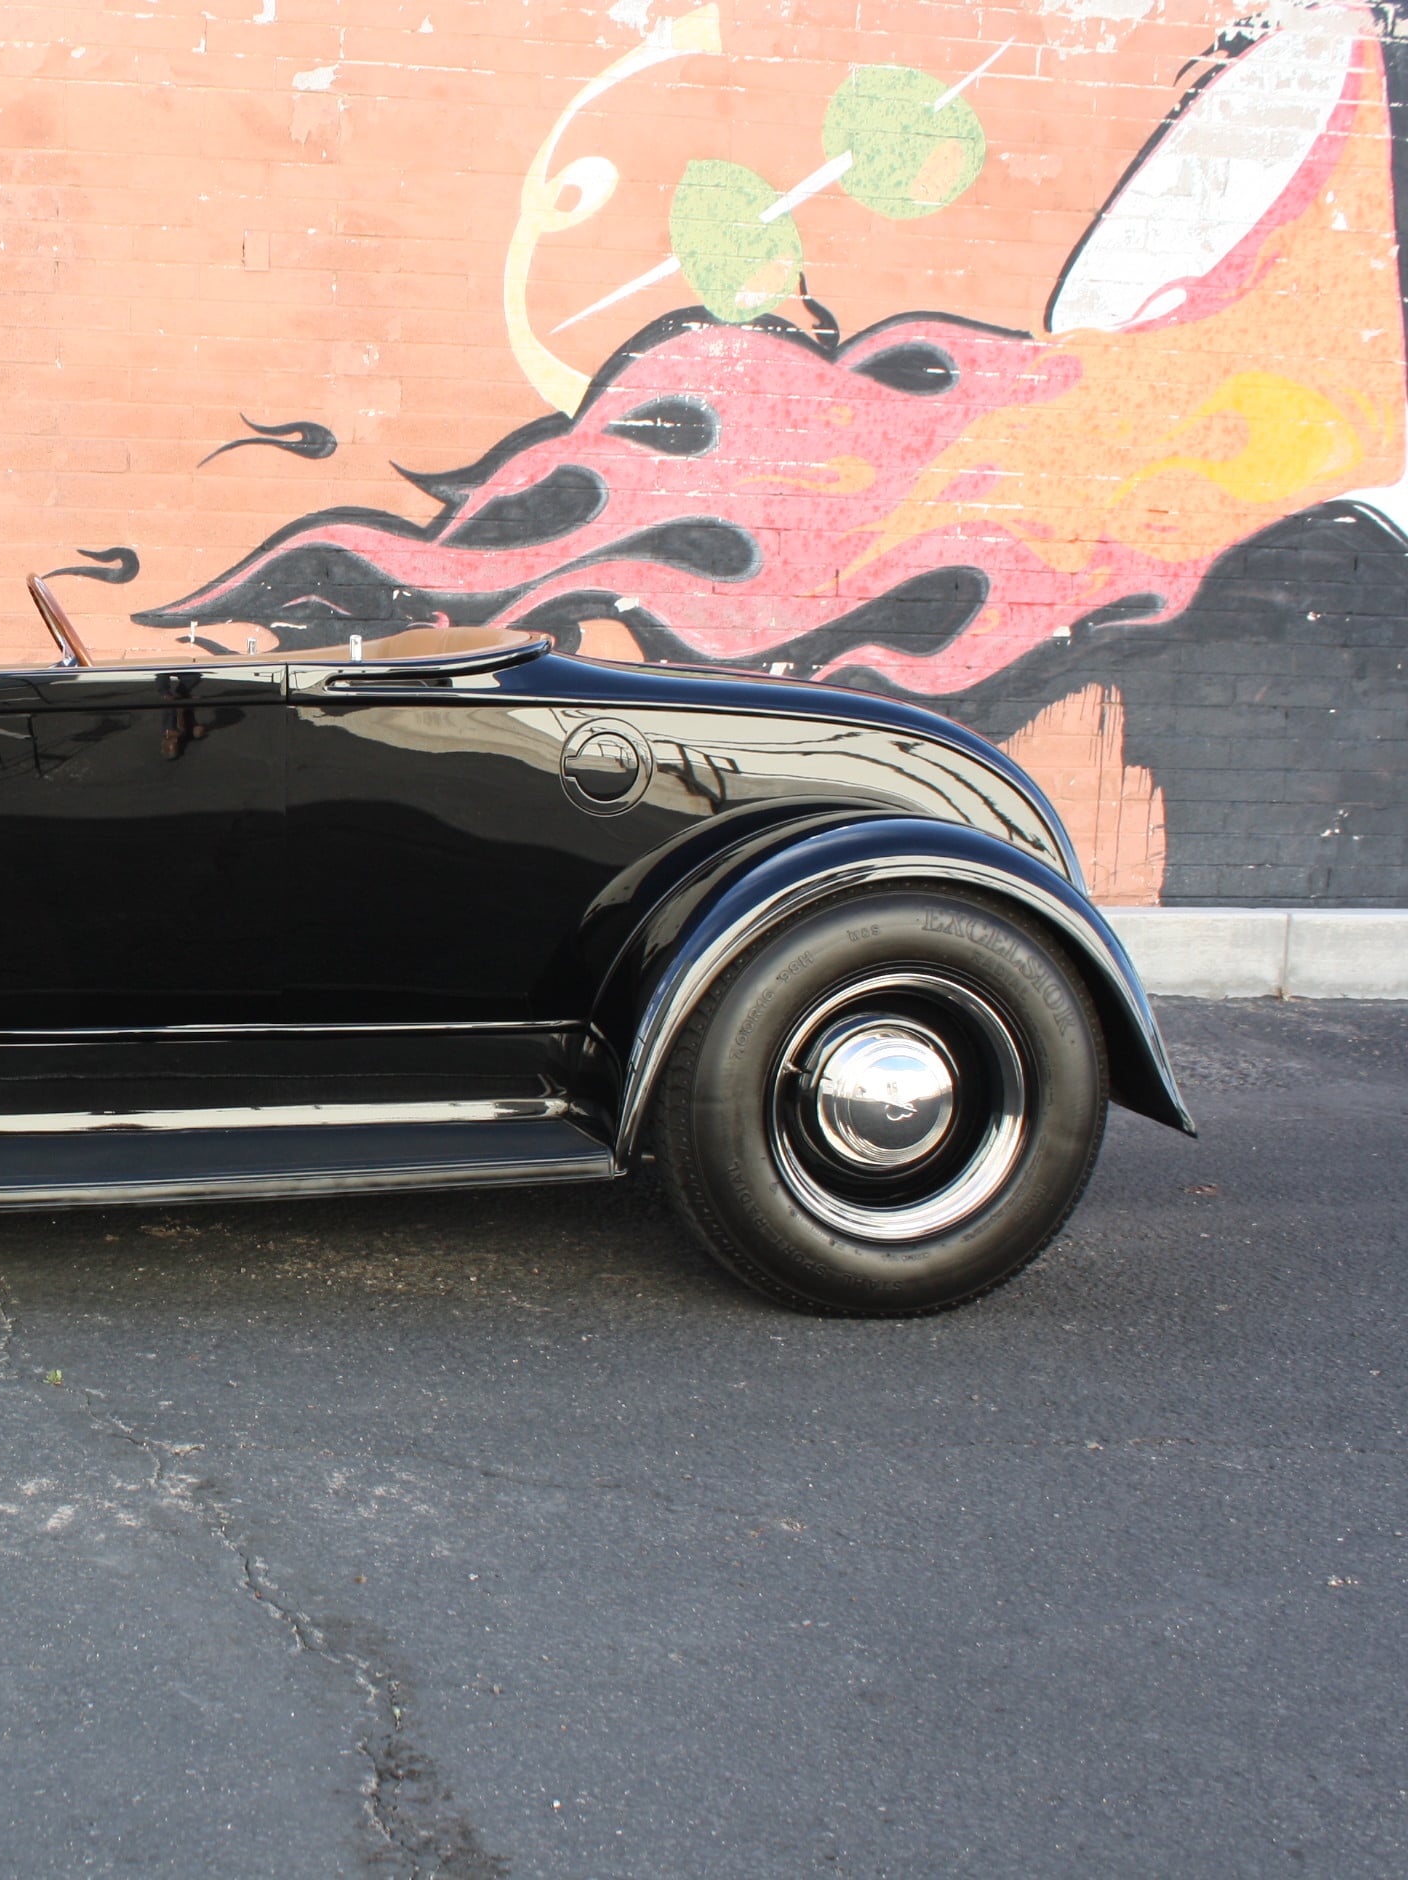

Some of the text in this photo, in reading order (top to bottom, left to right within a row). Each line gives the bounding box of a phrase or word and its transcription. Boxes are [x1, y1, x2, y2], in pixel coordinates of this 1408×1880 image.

[921, 908, 1076, 1037] EXCELSIOR
[971, 951, 1030, 1001] RADIAL
[727, 1160, 774, 1235] RADIAL
